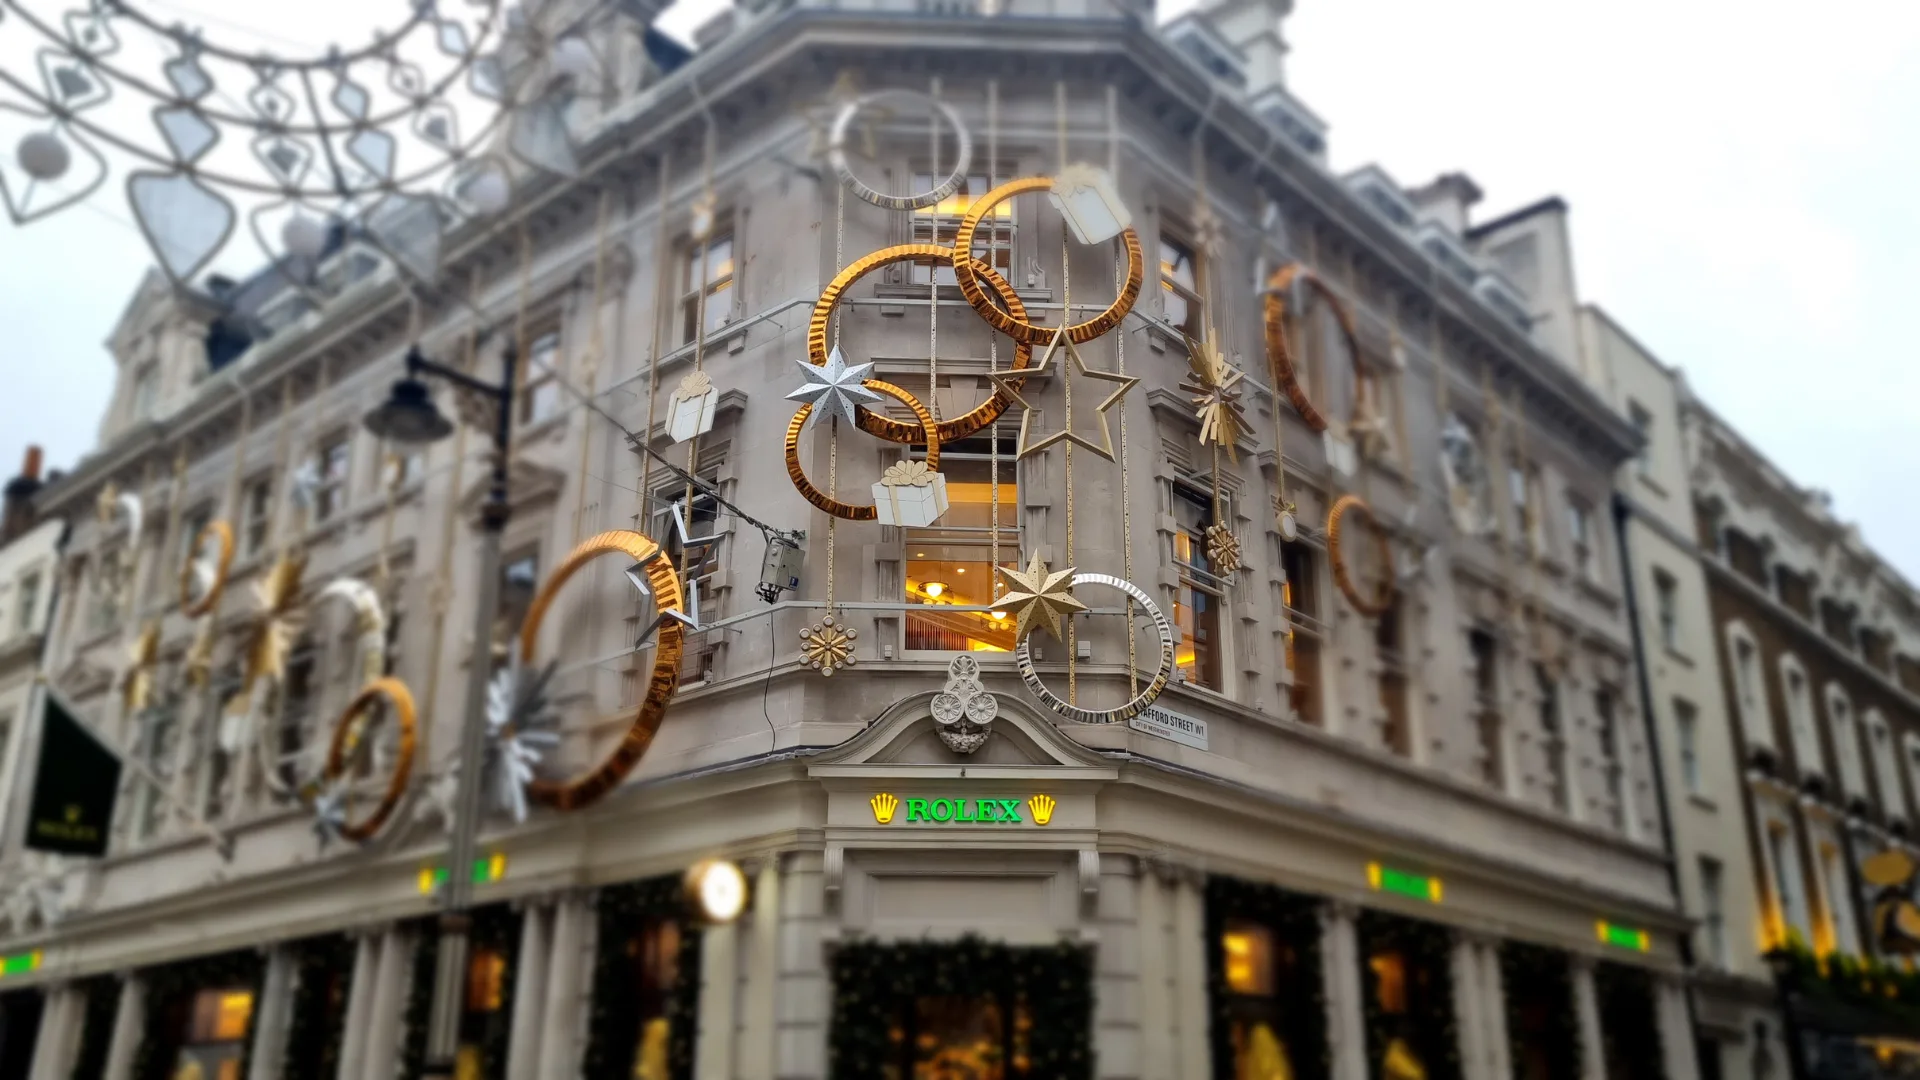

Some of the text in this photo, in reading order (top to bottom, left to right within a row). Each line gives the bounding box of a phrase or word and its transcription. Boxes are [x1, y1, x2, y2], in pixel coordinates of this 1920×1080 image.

[1139, 708, 1204, 736] TAFFORD STREET W1
[906, 798, 1022, 822] ROLEX
